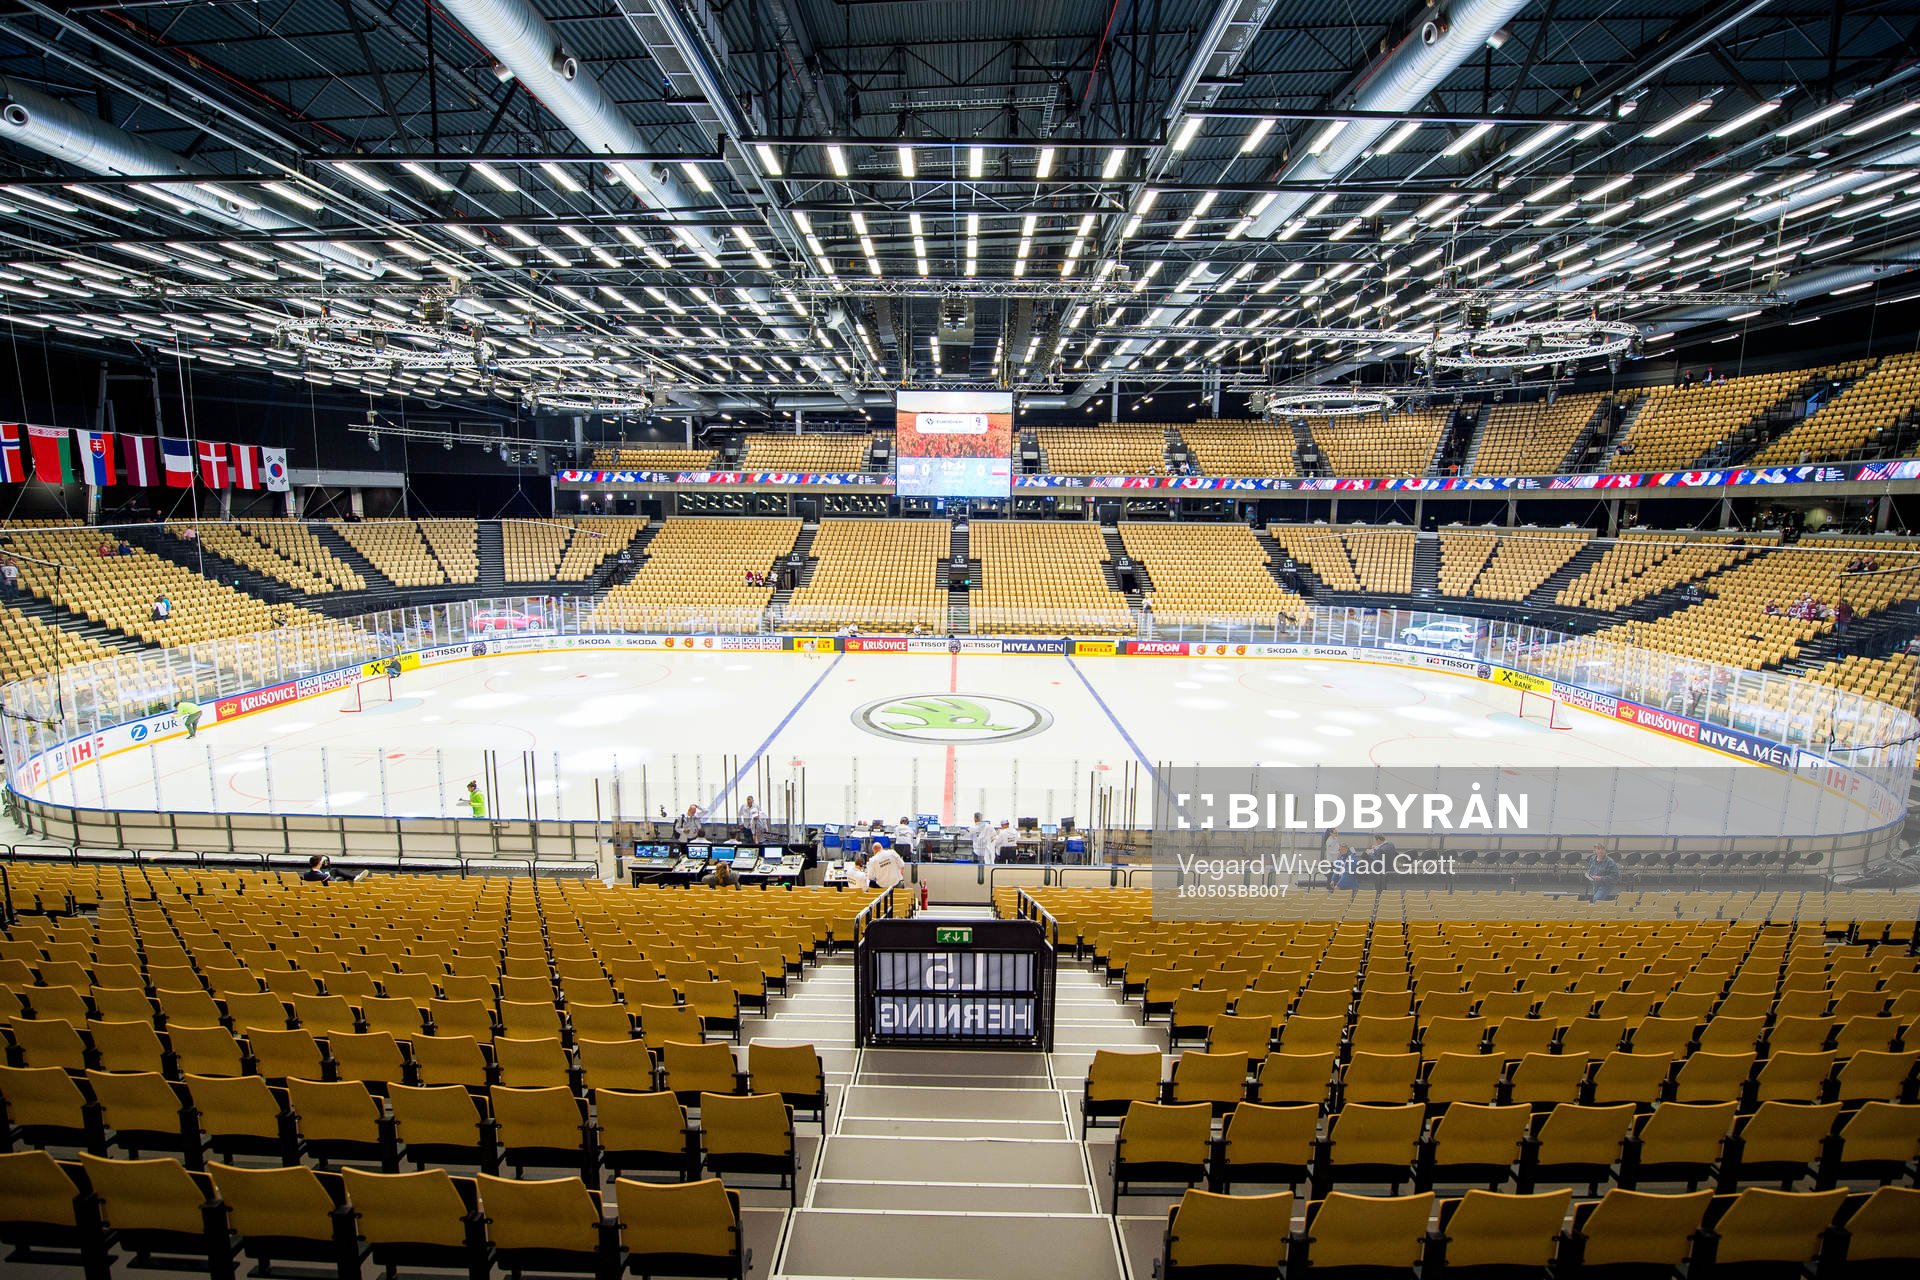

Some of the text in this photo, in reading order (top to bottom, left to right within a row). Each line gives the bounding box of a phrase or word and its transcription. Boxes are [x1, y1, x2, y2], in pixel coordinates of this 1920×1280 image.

[434, 645, 469, 657] TISSOT
[1004, 643, 1063, 652] NIVEA MEN
[1137, 643, 1180, 652] PATRON
[1441, 659, 1476, 671] TISSOT
[321, 671, 340, 684] LIQUI
[343, 666, 361, 678] LIQUI
[1514, 671, 1545, 686] Raiffeisen
[300, 677, 319, 689] LIQUI
[322, 679, 342, 692] MOLY
[343, 674, 362, 685] MOLY
[1514, 680, 1532, 691] BANK
[299, 685, 321, 698] MOLY
[1553, 682, 1571, 694] LIQUI
[1573, 688, 1592, 701] LIQUI
[240, 686, 296, 712] KRUŠOVICE
[1552, 690, 1571, 702] MOLY
[1595, 694, 1616, 707] LIQUI
[1572, 696, 1592, 710] MOLY
[1594, 703, 1615, 716] MOLY
[1637, 709, 1696, 739] KRUŠOVICE
[1700, 727, 1799, 769] NIVEA MEN
